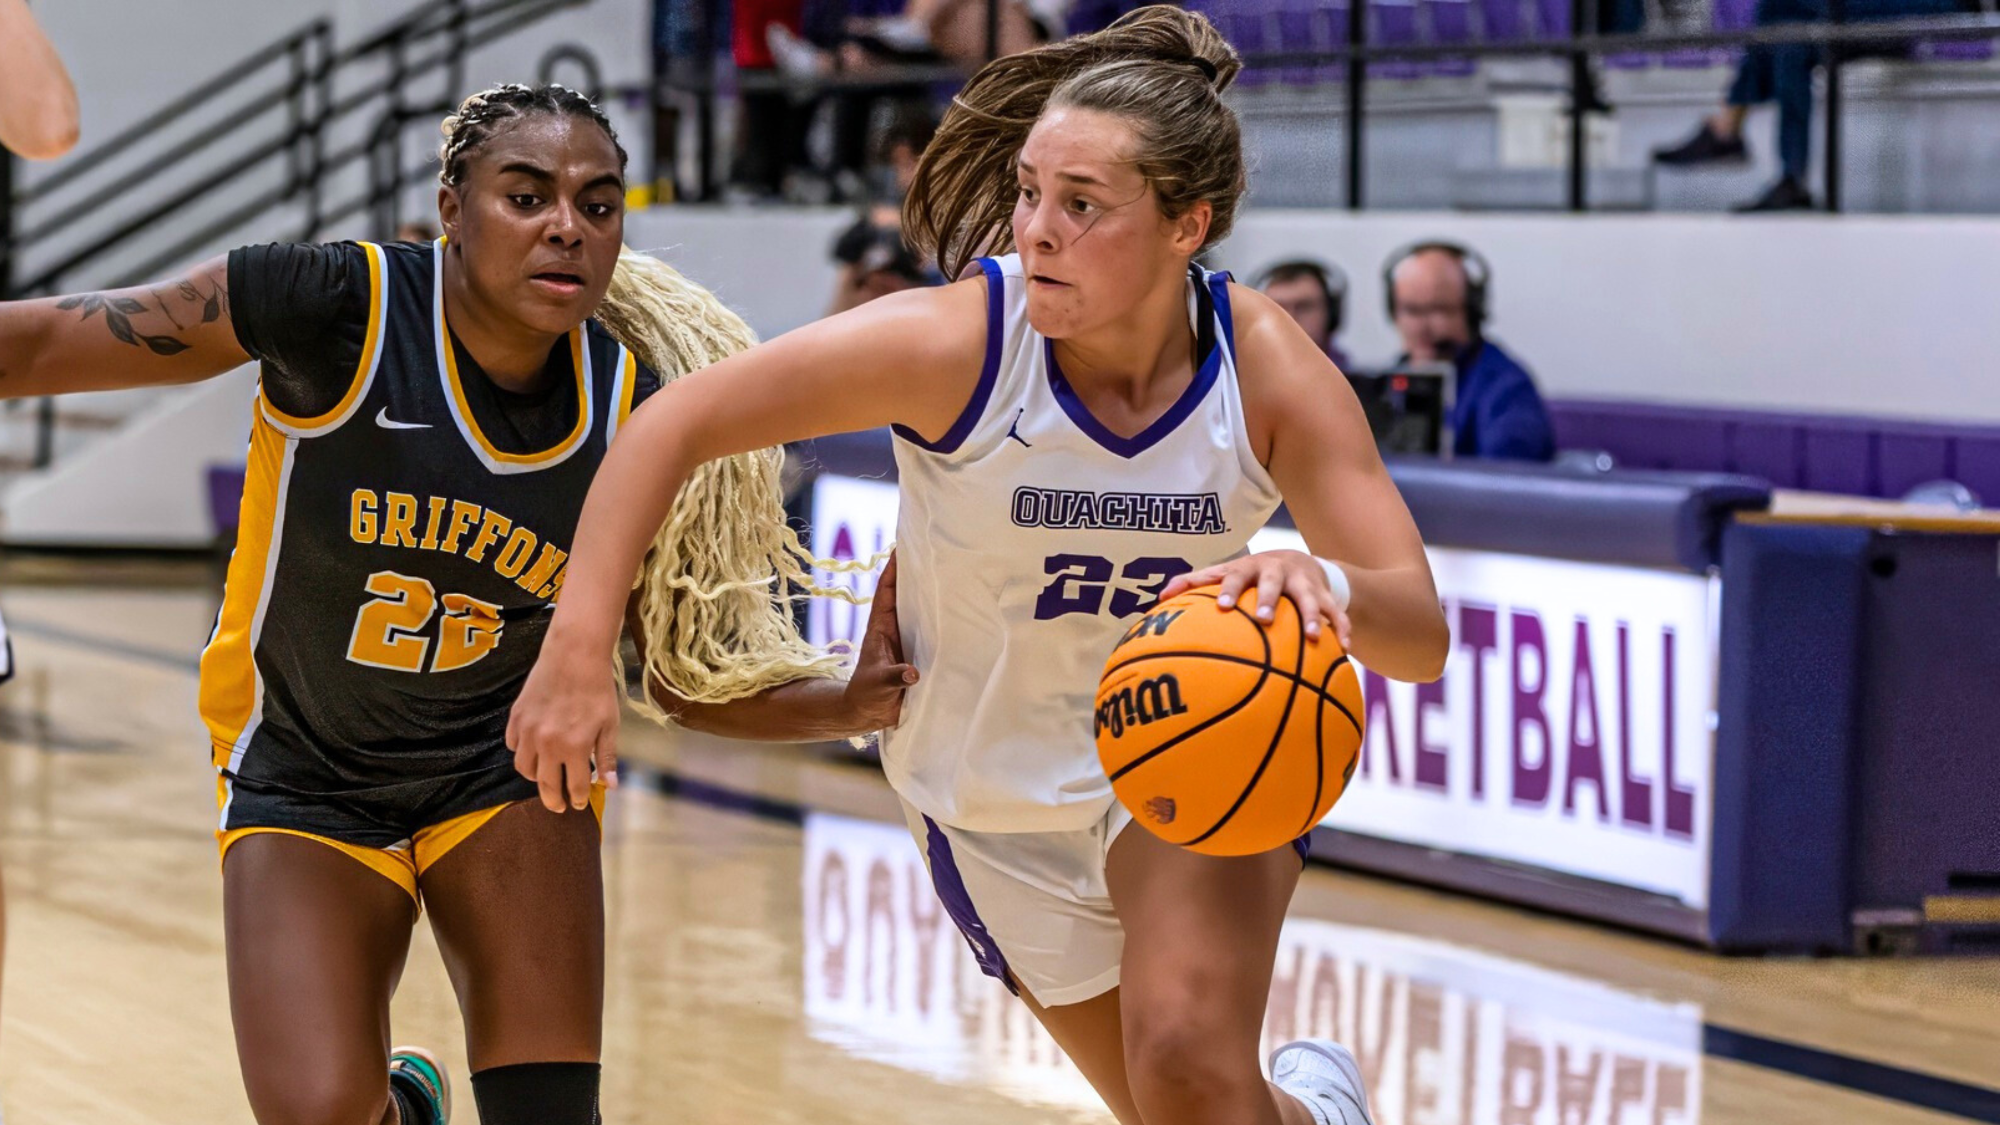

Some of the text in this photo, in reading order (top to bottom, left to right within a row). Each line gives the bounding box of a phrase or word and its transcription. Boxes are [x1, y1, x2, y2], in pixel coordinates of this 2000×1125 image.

[1011, 486, 1226, 534] OUACHITA
[1033, 553, 1194, 620] 23
[346, 570, 506, 673] 22
